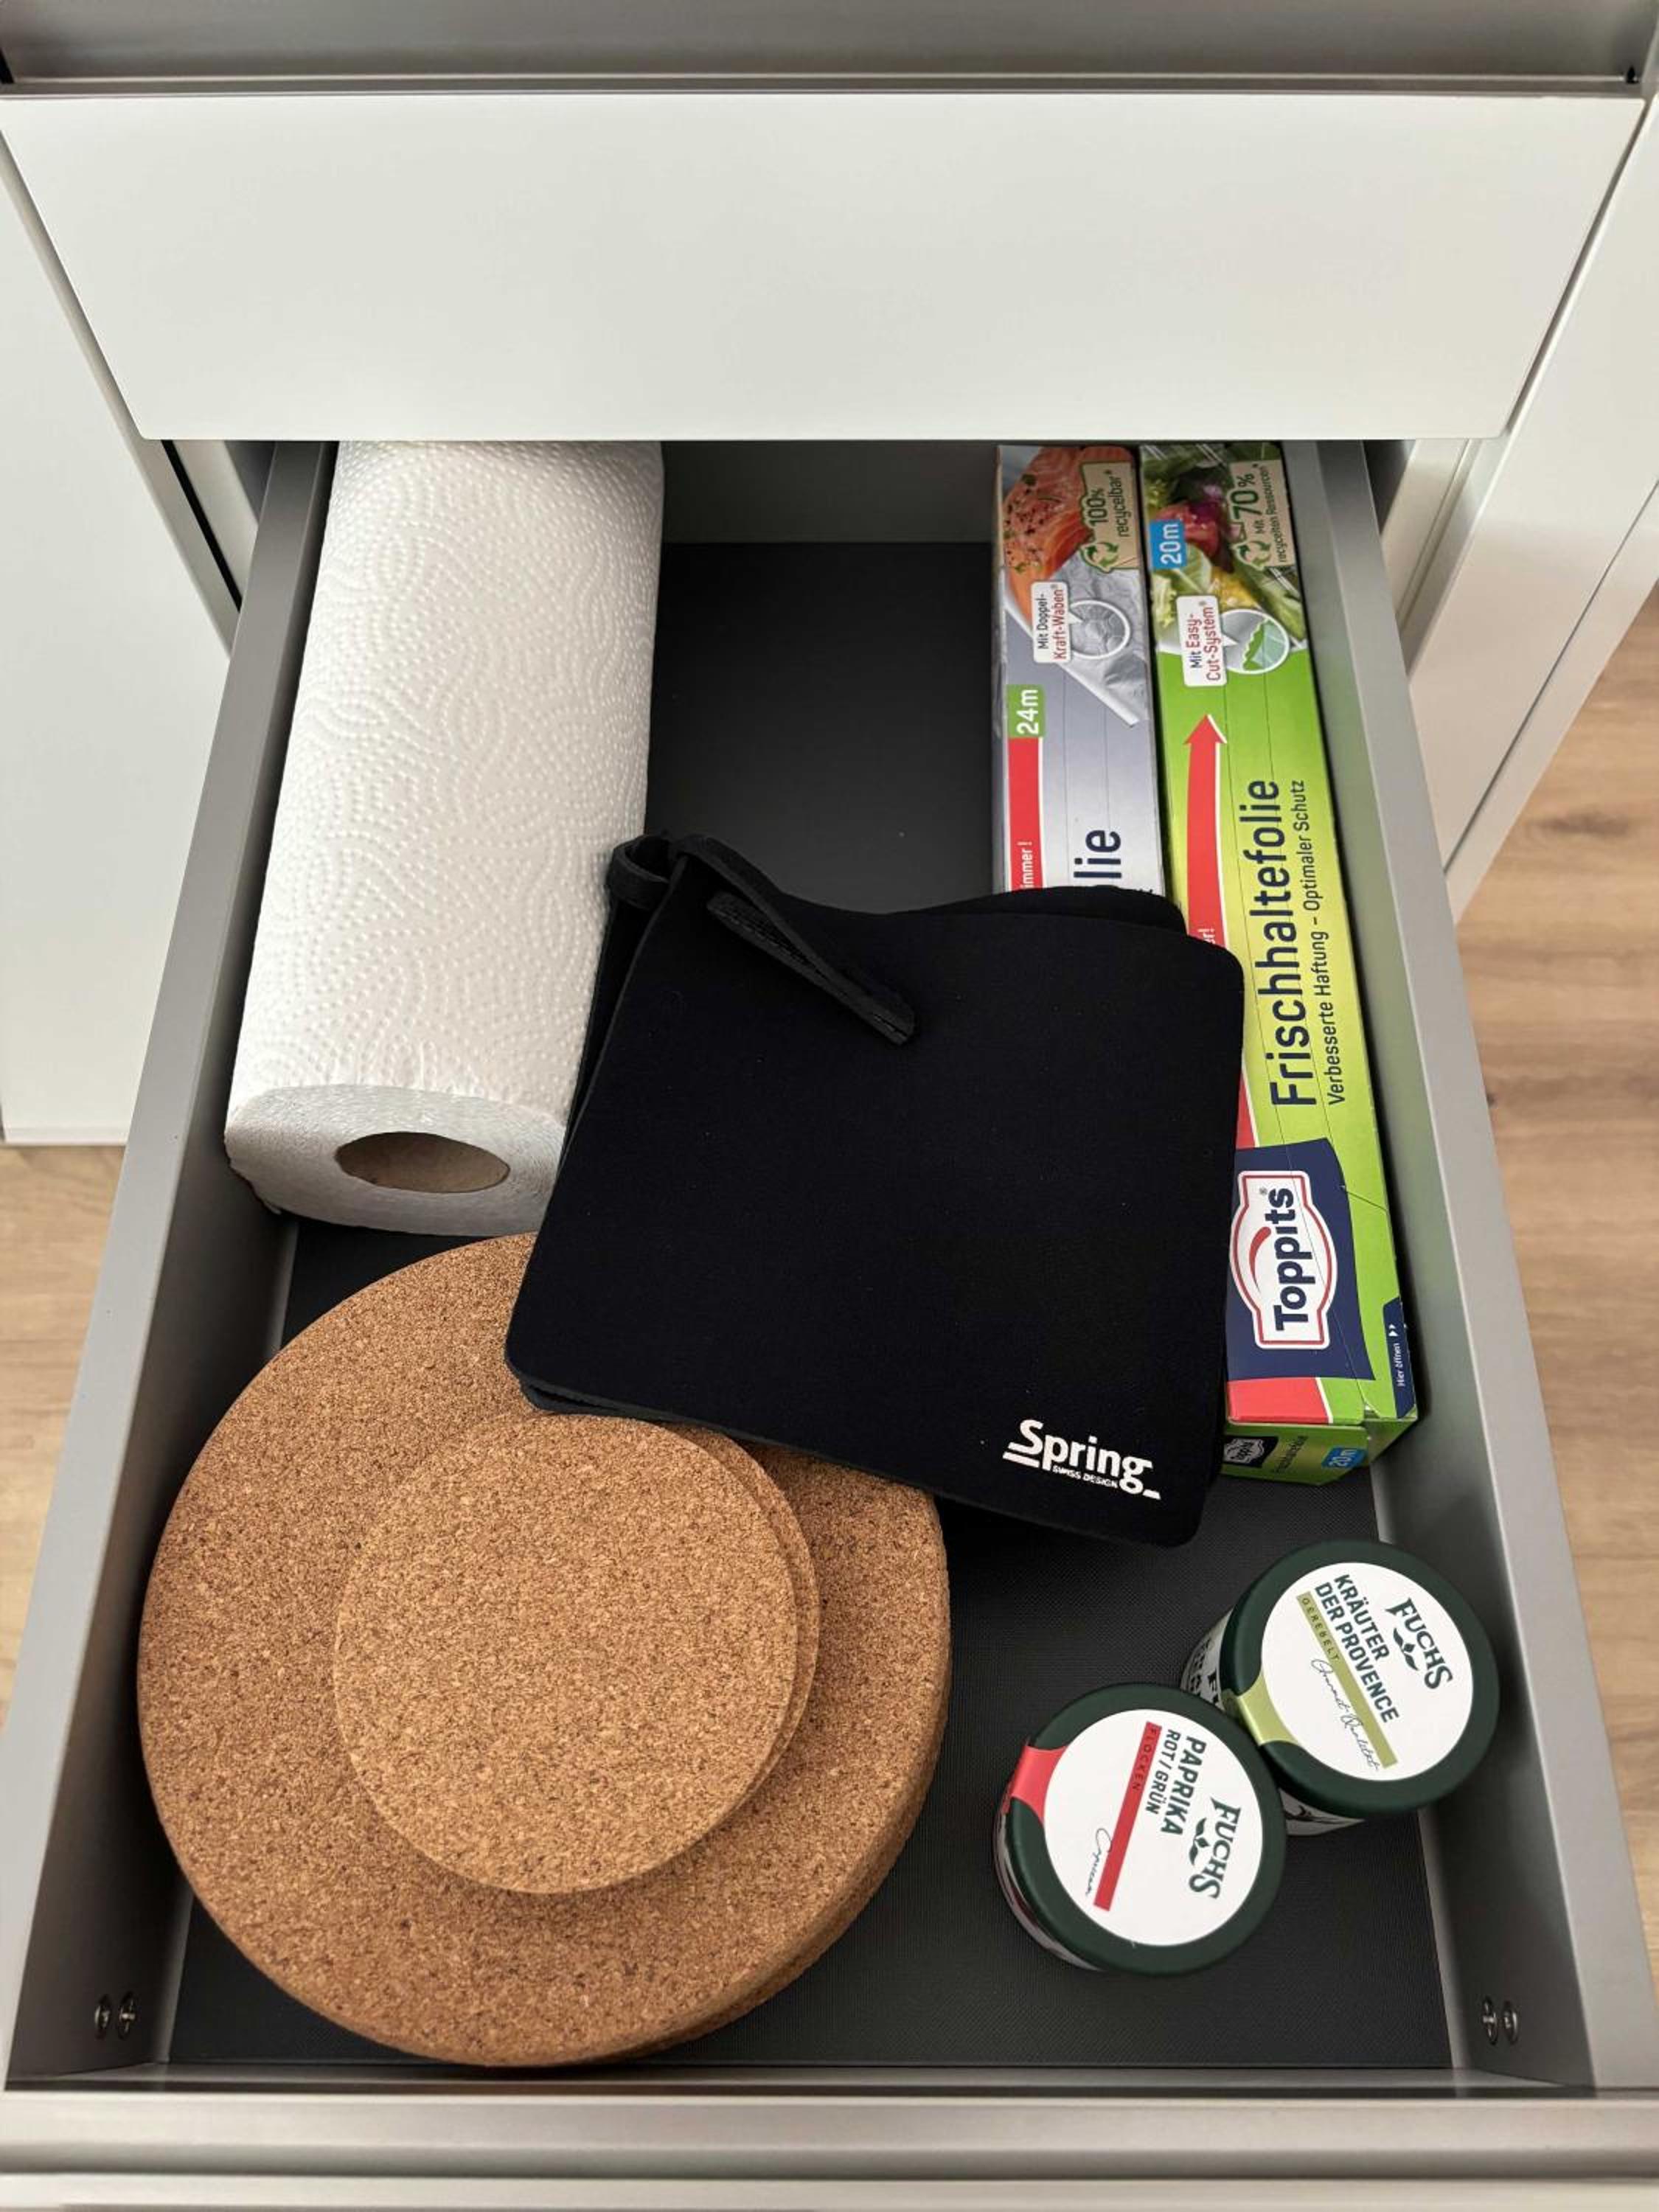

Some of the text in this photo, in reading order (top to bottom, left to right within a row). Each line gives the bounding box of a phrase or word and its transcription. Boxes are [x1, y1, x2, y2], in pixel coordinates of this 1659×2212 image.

[1086, 488, 1108, 526] 100%
[1254, 519, 1265, 534] Mit
[1161, 524, 1182, 564] 20m
[1035, 594, 1049, 649] Mit Doppel-
[1052, 589, 1067, 659] Kraft-Waben
[1186, 613, 1202, 669] Mit Easy-
[1203, 607, 1221, 681] Cut-System
[1017, 689, 1039, 734] 24m
[1291, 779, 1310, 832] Schutz
[1295, 834, 1321, 911] Optimaler
[1239, 780, 1317, 1105] Frischhaltefolie
[1310, 931, 1331, 996] Haftung
[1319, 1001, 1346, 1105] Verbesserte
[1265, 1188, 1315, 1331] Toppits
[1003, 1419, 1161, 1500] Spring
[1315, 1582, 1399, 1723] DER PROVENCE
[1334, 1574, 1390, 1662] KRÄUTER
[1385, 1598, 1453, 1689] FUCHS
[1132, 1727, 1158, 1792] FLOCKEN
[1161, 1728, 1181, 1759] ROT
[1144, 1772, 1170, 1815] GRÜN
[1161, 1735, 1207, 1836] PAPRIKA
[1189, 1796, 1241, 1899] FUCHS
